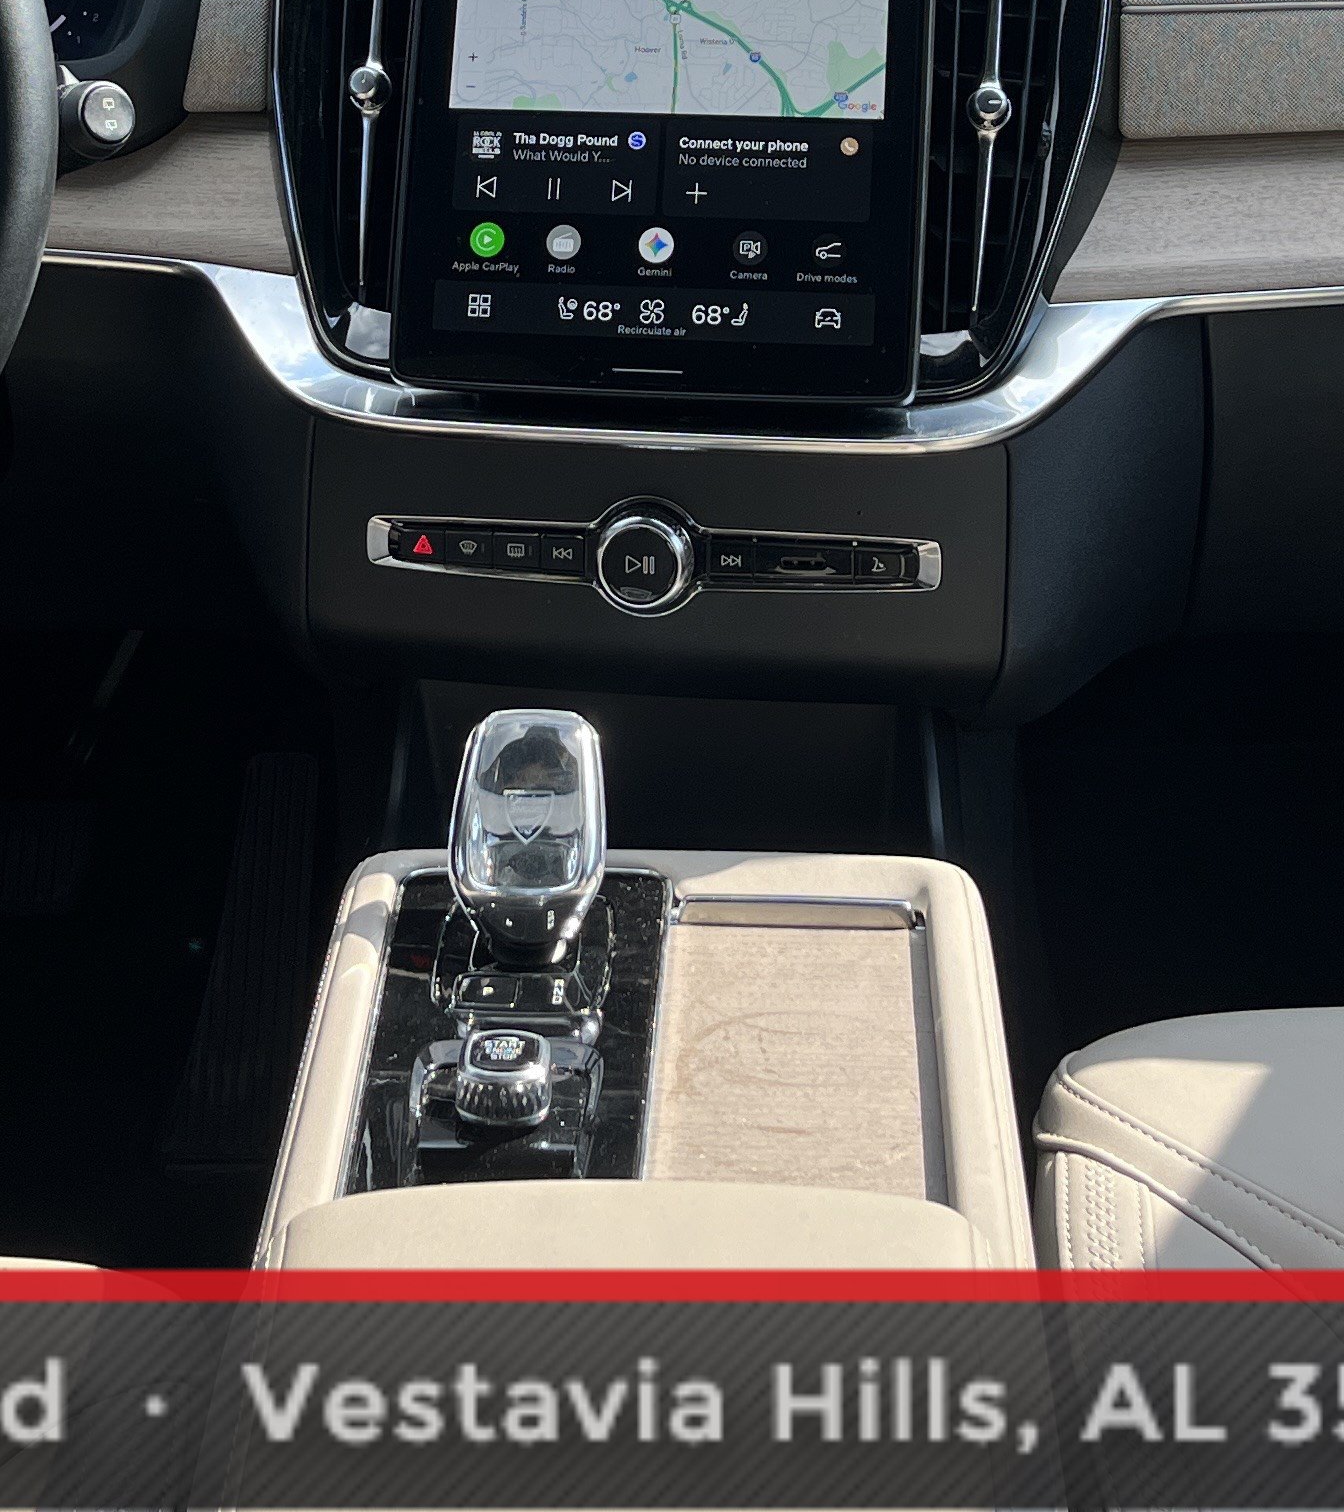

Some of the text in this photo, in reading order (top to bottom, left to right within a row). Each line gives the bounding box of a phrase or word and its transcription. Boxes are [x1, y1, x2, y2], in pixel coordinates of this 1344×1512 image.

[92, 13, 99, 22] 2
[837, 99, 878, 113] Google
[513, 132, 619, 148] Tha Dogg Pound
[679, 137, 809, 154] Connect your phone
[513, 149, 546, 162] What
[549, 150, 589, 163] Would
[678, 153, 808, 169] No device connected
[452, 261, 519, 275] Apple CarPlay
[547, 264, 576, 274] Radio
[637, 267, 672, 277] Gemini
[729, 270, 768, 281] Camera
[796, 272, 858, 284] Drive modes
[617, 324, 687, 337] Recirculate air
